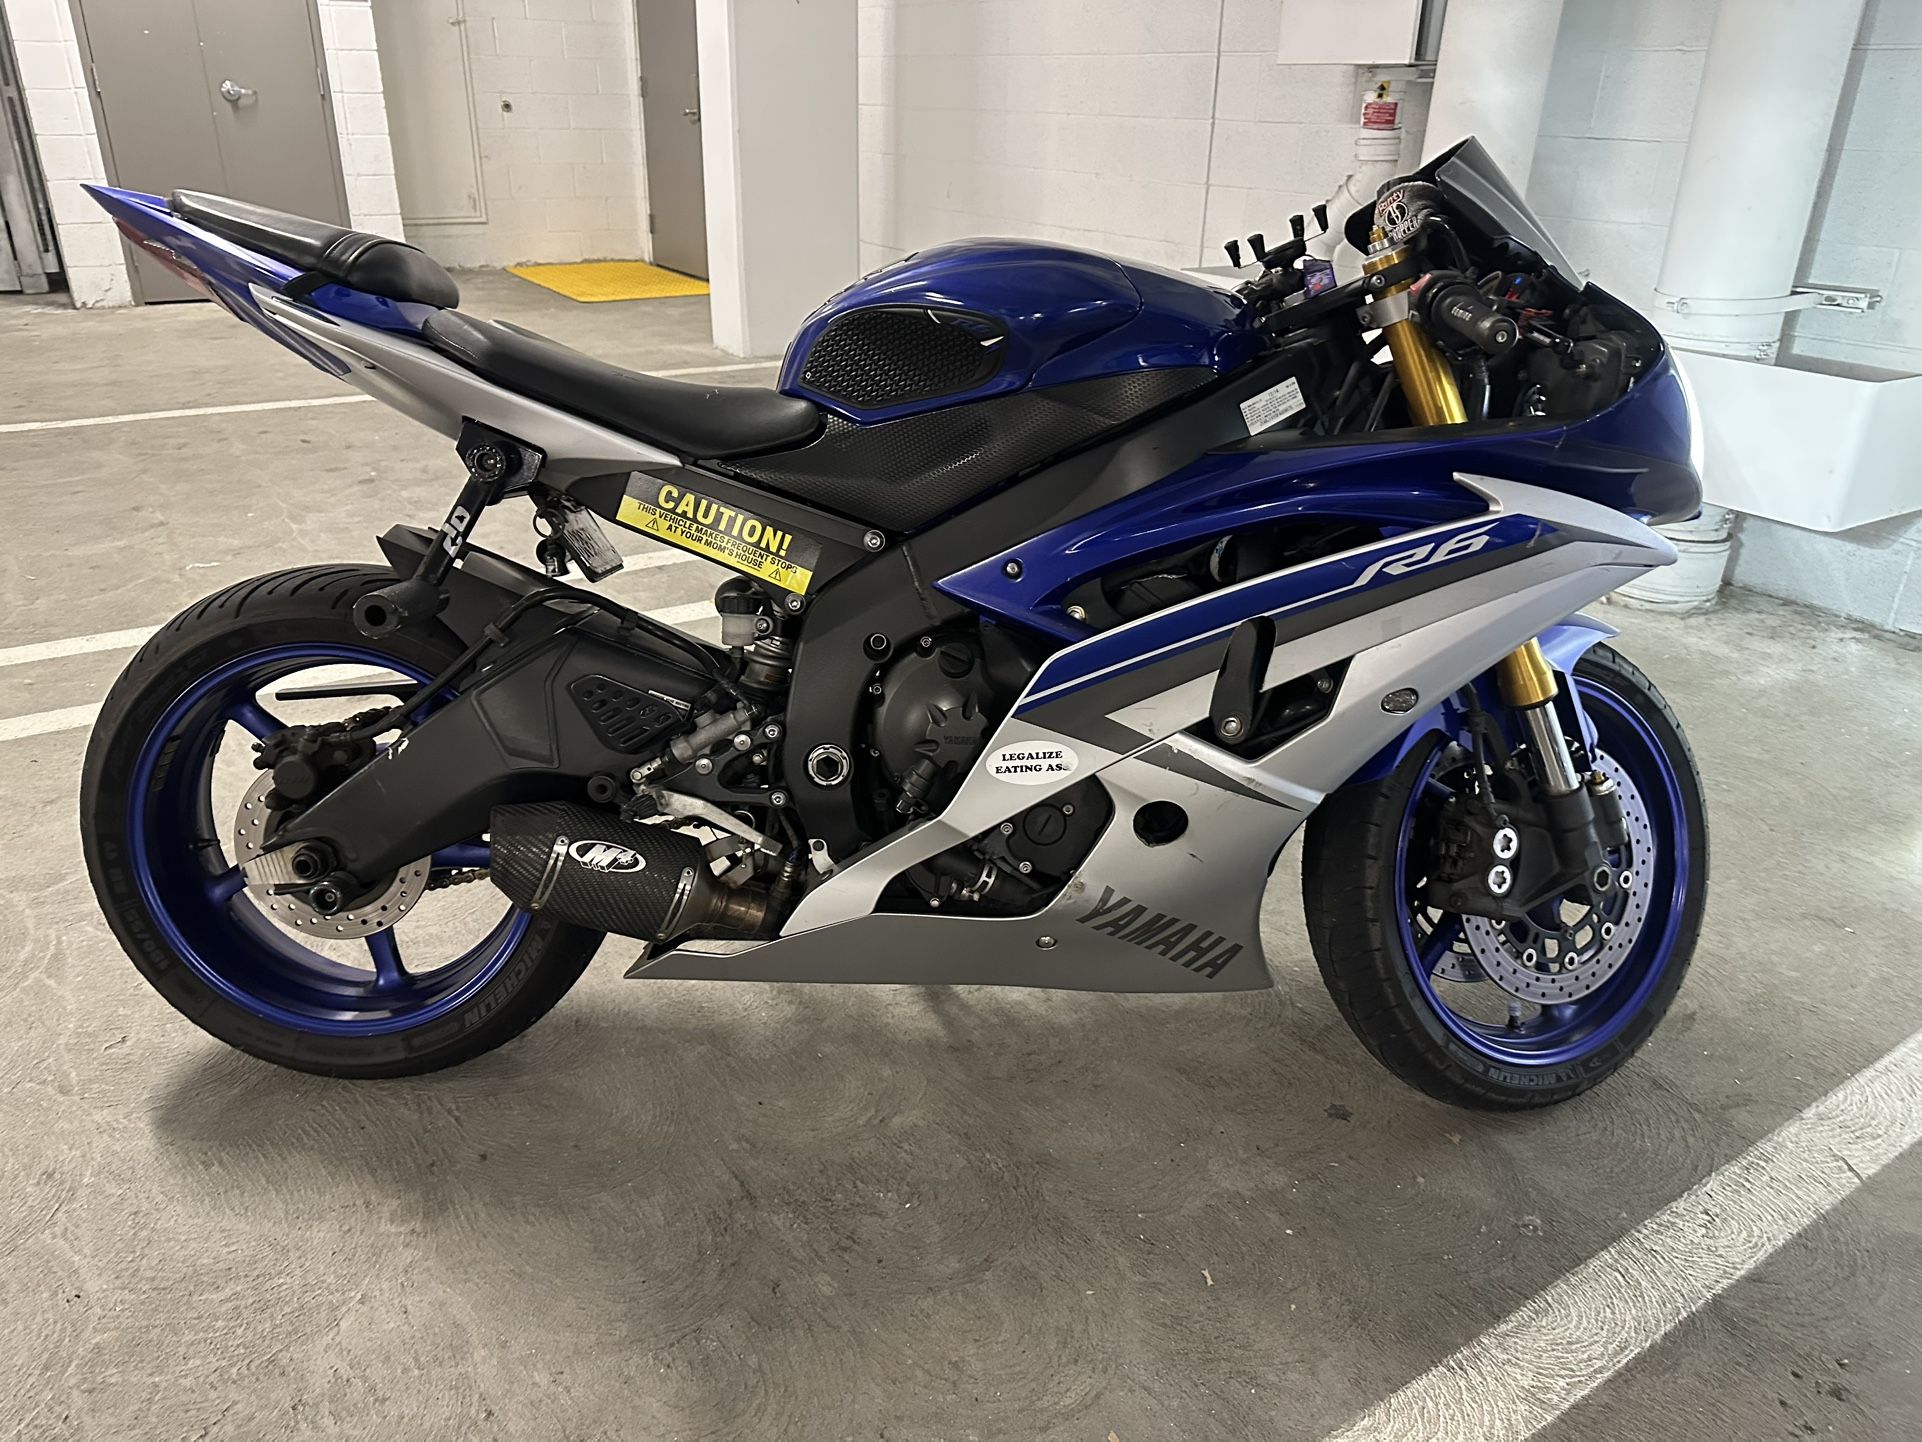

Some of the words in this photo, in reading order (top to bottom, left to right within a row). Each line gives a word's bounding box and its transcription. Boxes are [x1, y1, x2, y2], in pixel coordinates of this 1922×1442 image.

[637, 502, 657, 517] THIS
[659, 509, 694, 531] VEHICLE
[694, 522, 725, 544] MAKES
[726, 534, 770, 562] FREQUENT
[769, 558, 798, 574] STOPS
[658, 485, 793, 556] CAUTION!
[666, 524, 680, 534] AT
[680, 528, 703, 544] YOUR
[703, 538, 734, 556] MOM'S
[734, 551, 764, 569] HOUSE
[1353, 521, 1500, 587] R6
[995, 764, 1042, 774] EATING
[1002, 751, 1063, 762] LEGALIZE
[1075, 885, 1244, 979] YAMAHA
[463, 935, 544, 1028] MICHELIN
[1488, 1067, 1557, 1085] MICHELIN
